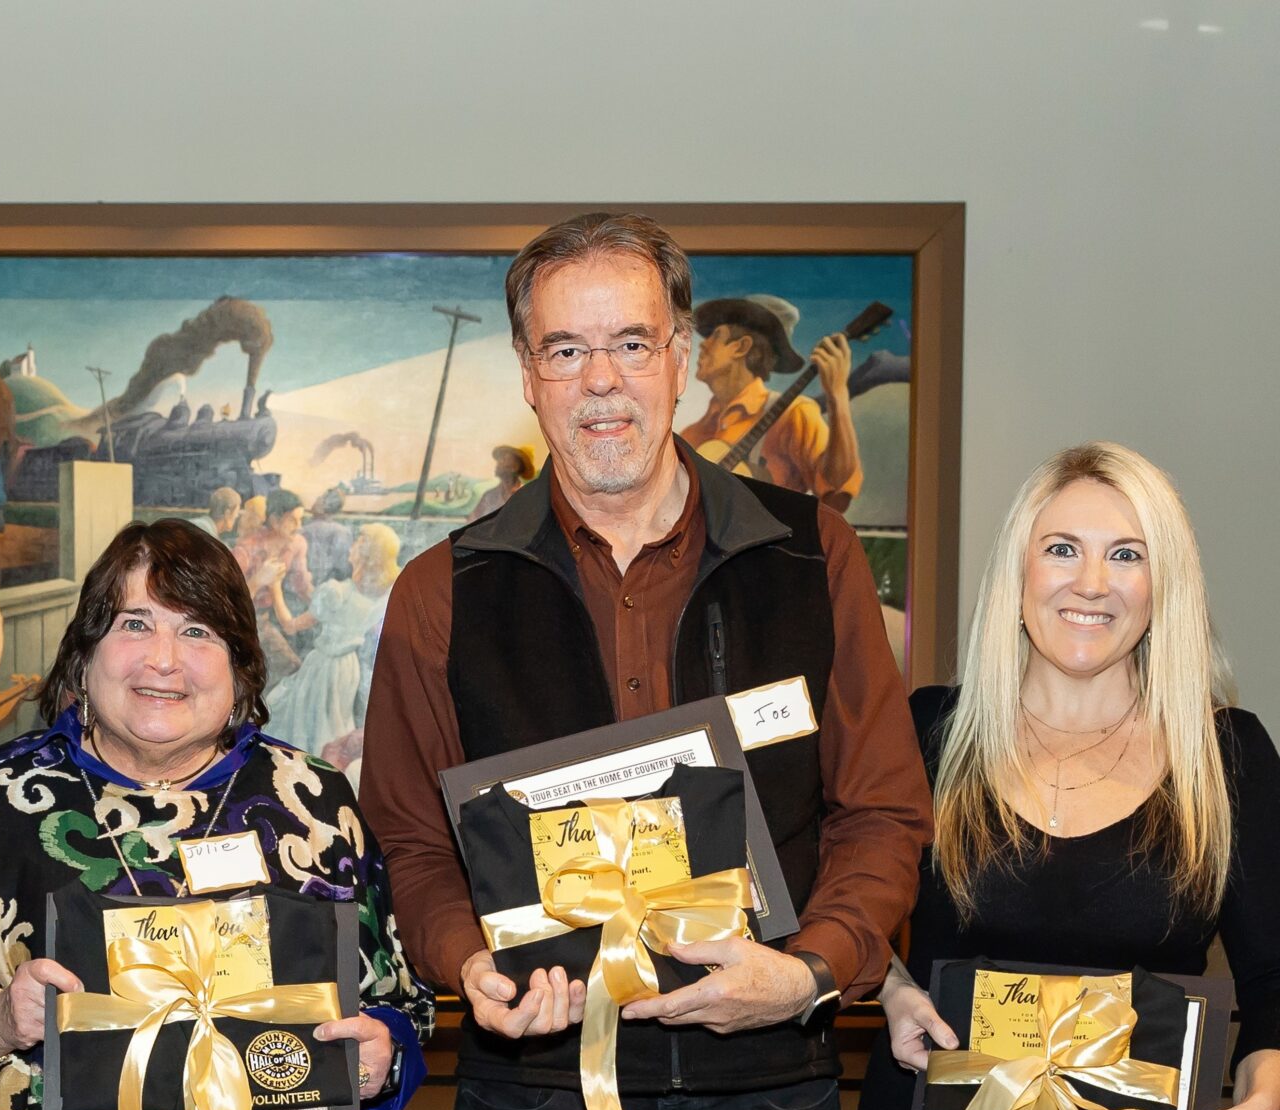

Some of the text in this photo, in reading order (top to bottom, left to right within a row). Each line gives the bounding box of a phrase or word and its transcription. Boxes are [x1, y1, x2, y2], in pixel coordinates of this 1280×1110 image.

[531, 790, 552, 802] YOUR
[553, 785, 570, 797] SEAT
[574, 782, 581, 791] IN
[584, 779, 597, 789] THE
[599, 772, 622, 785] HOME
[624, 769, 632, 778] OF
[635, 760, 668, 776] COUNTRY
[670, 752, 696, 765] MUSIC
[556, 811, 596, 847] Tha
[134, 910, 178, 941] Than
[998, 977, 1038, 1005] Tha
[253, 1033, 304, 1051] COUNTRY
[261, 1042, 293, 1054] MUSIC
[250, 1053, 273, 1071] HALL
[285, 1050, 308, 1066] FAME
[254, 1069, 305, 1087] NASHVILLE
[265, 1066, 296, 1078] MUSEUM
